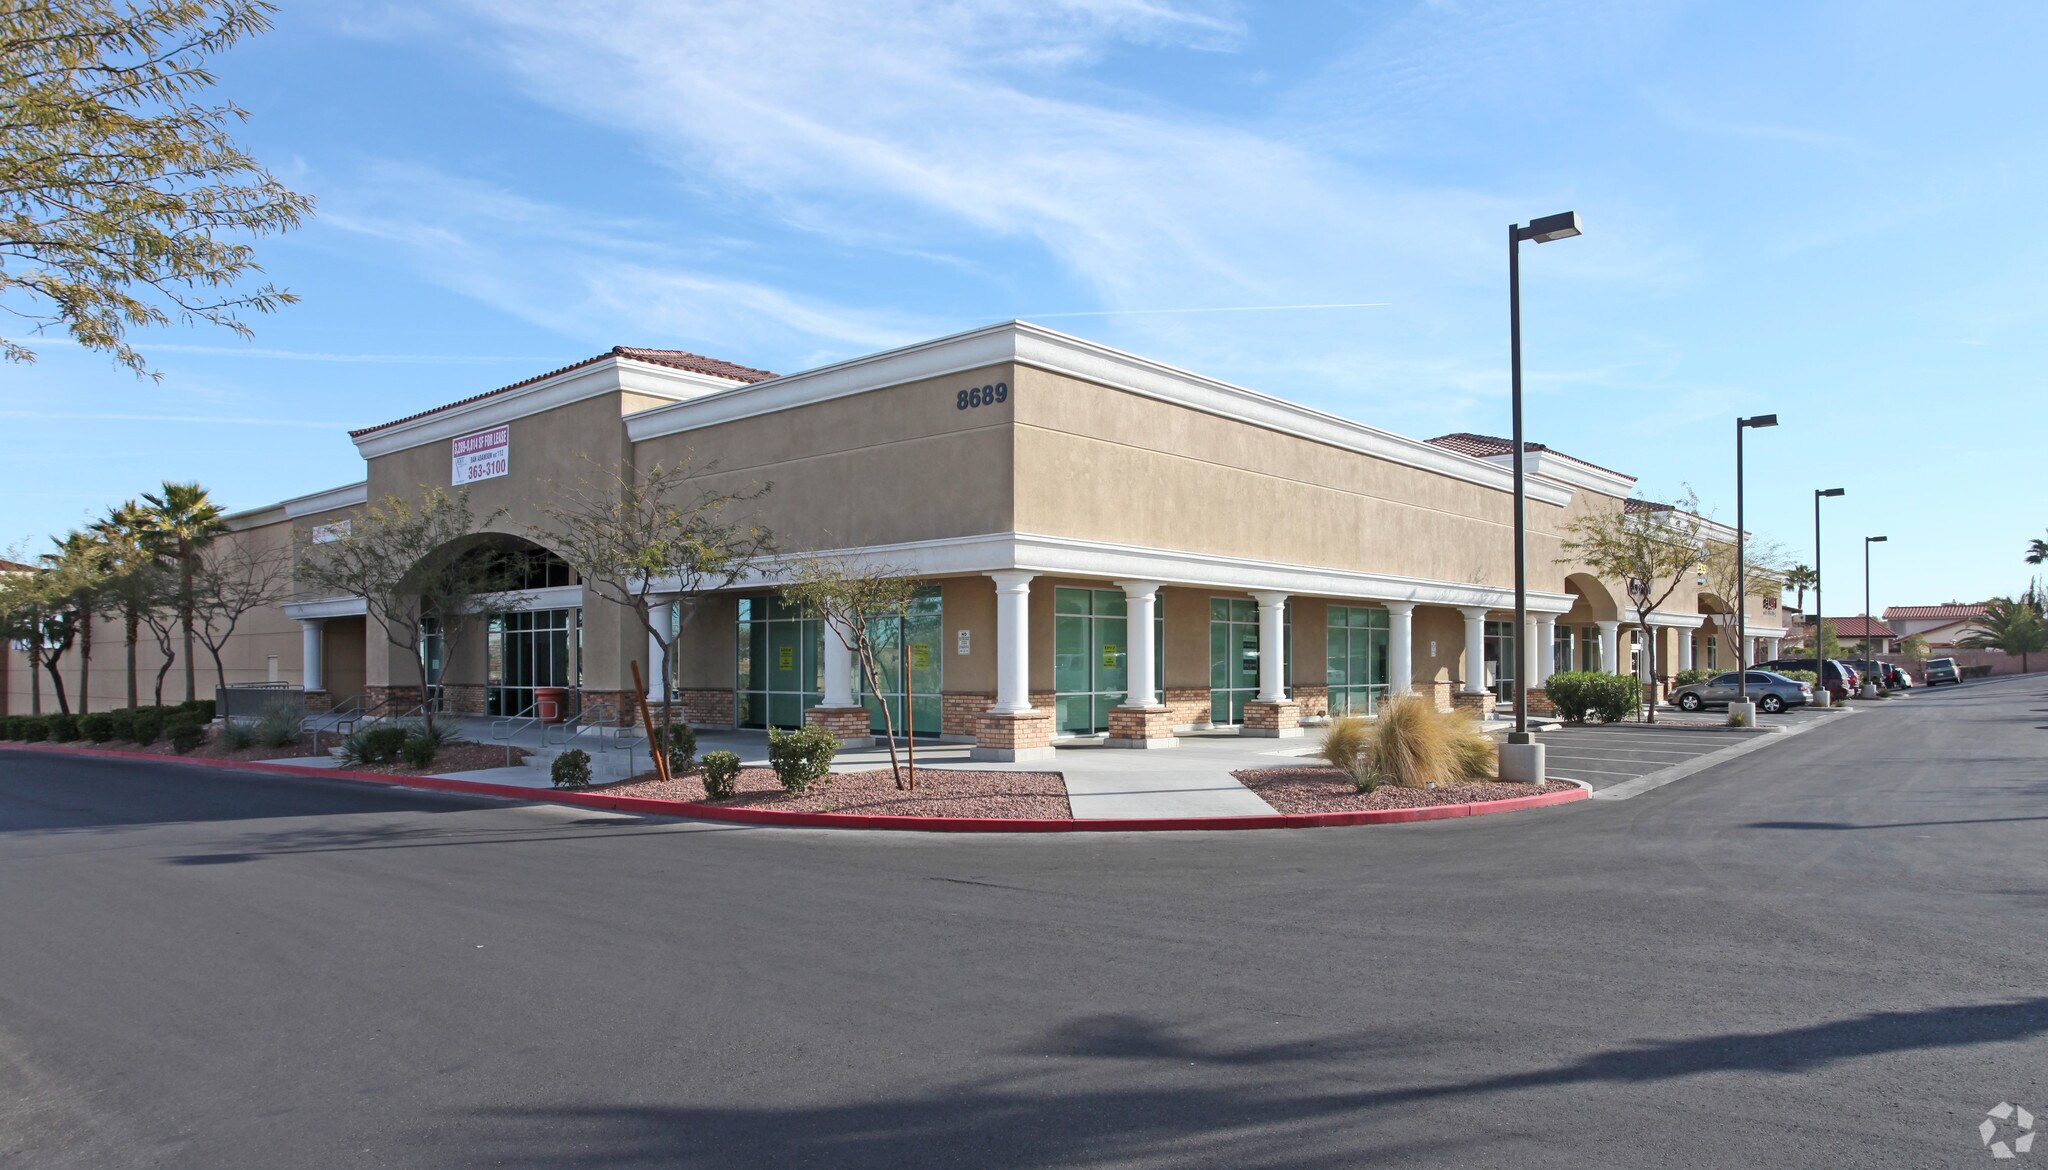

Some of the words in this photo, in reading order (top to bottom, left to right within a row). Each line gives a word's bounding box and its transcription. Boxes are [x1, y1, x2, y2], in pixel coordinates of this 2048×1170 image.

[957, 382, 1007, 410] 8689
[485, 433, 493, 447] FOR
[494, 430, 507, 445] LEASE
[468, 459, 506, 480] 363-3100
